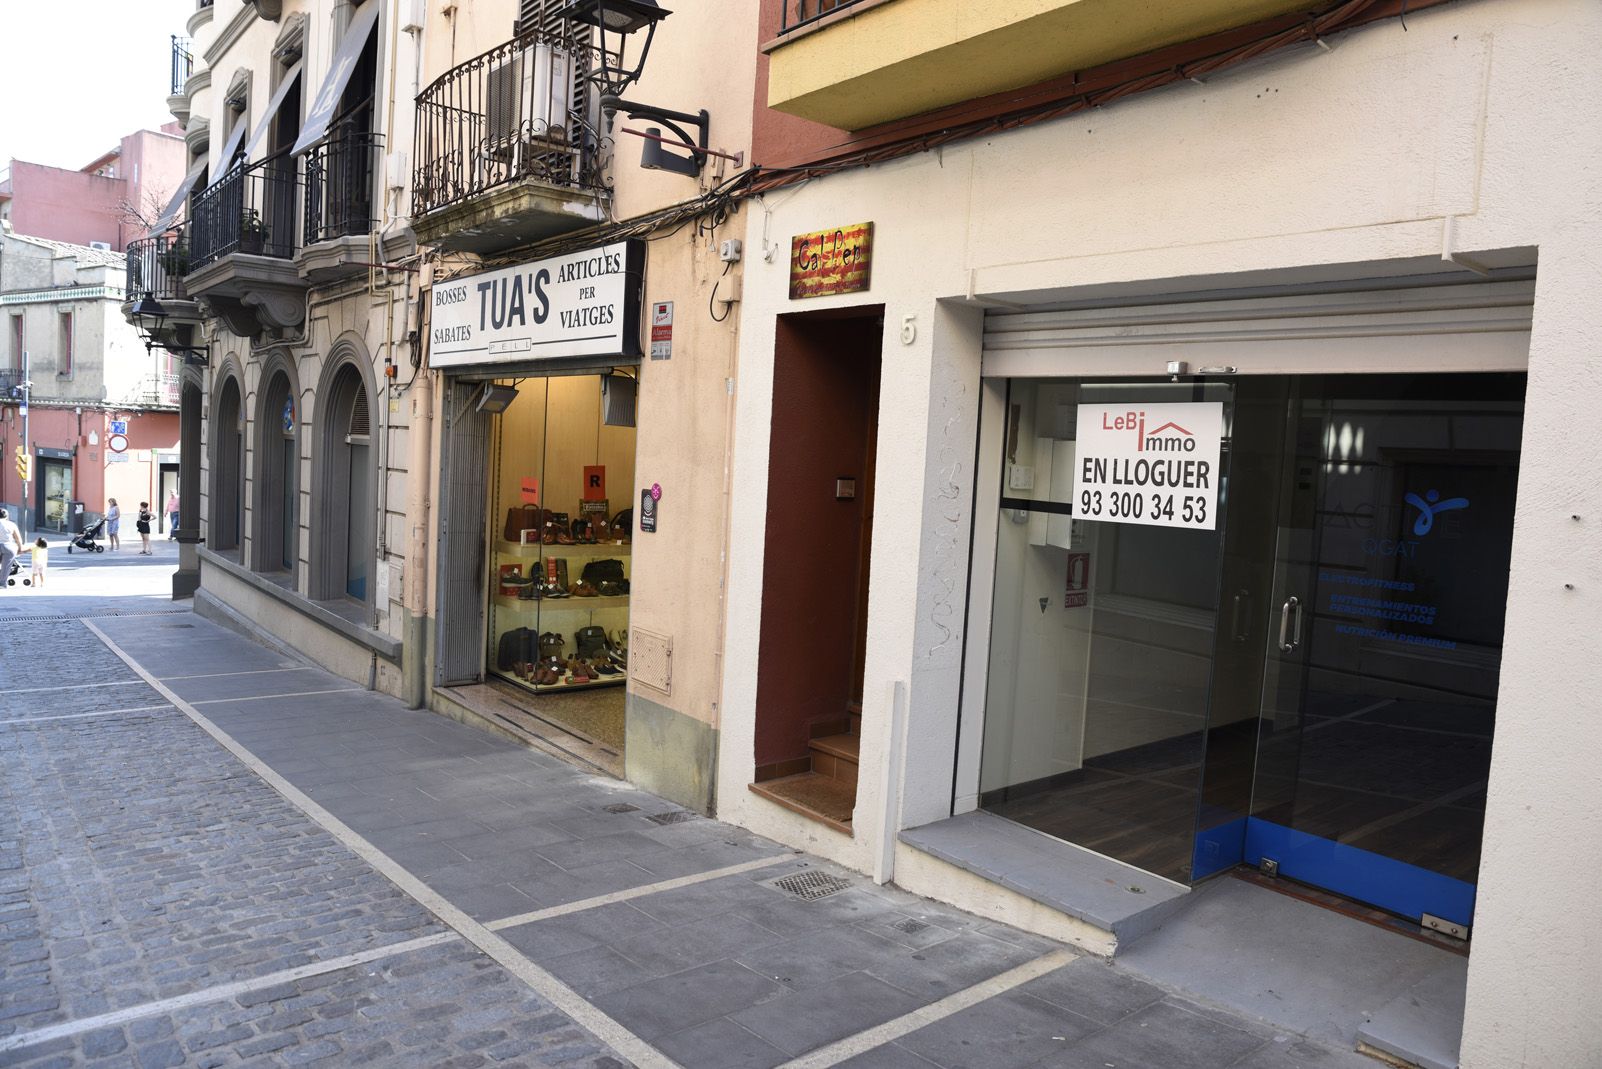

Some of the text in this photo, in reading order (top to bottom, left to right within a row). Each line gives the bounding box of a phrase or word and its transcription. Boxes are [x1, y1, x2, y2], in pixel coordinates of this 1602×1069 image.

[798, 230, 862, 272] Cal Pep
[558, 252, 620, 283] ARTICLES
[435, 285, 467, 306] BOSSES
[477, 268, 550, 332] TUA'S
[579, 286, 595, 300] PER
[560, 303, 614, 328] VIATGES
[899, 312, 916, 345] 5
[433, 324, 472, 345] SABATES
[1082, 457, 1210, 489] EN LLOGUER
[1081, 489, 1207, 523] 93 300 34 53
[1329, 603, 1435, 625] PERSONALIZADOS
[1330, 593, 1437, 615] ENTRENAMIENTOS
